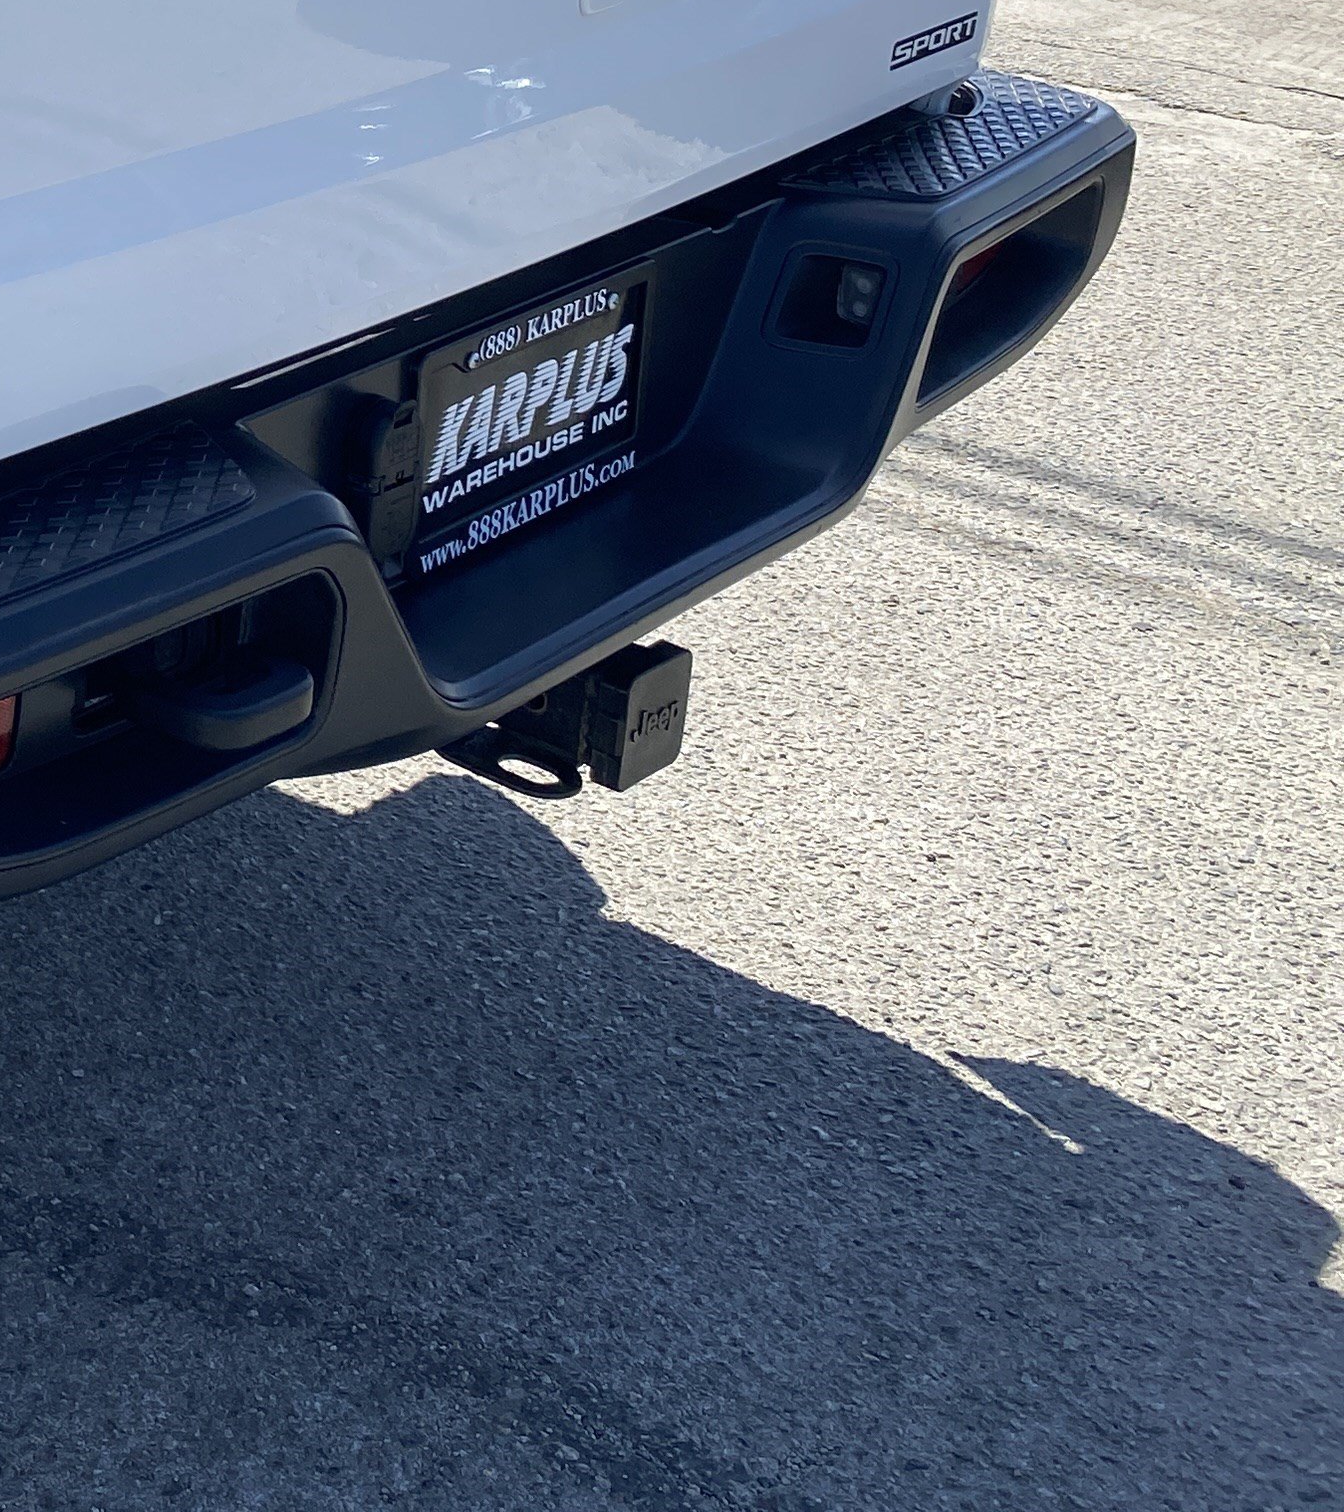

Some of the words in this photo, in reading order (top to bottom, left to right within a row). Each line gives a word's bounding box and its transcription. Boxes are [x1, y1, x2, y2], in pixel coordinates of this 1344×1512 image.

[893, 15, 978, 64] SPORT
[478, 325, 522, 362] (888)
[525, 288, 608, 343] KARPLUS
[424, 323, 635, 485] KARPLUS
[422, 421, 585, 514] WAREHOUSE
[591, 399, 629, 435] INC
[630, 699, 681, 743] Jeep
